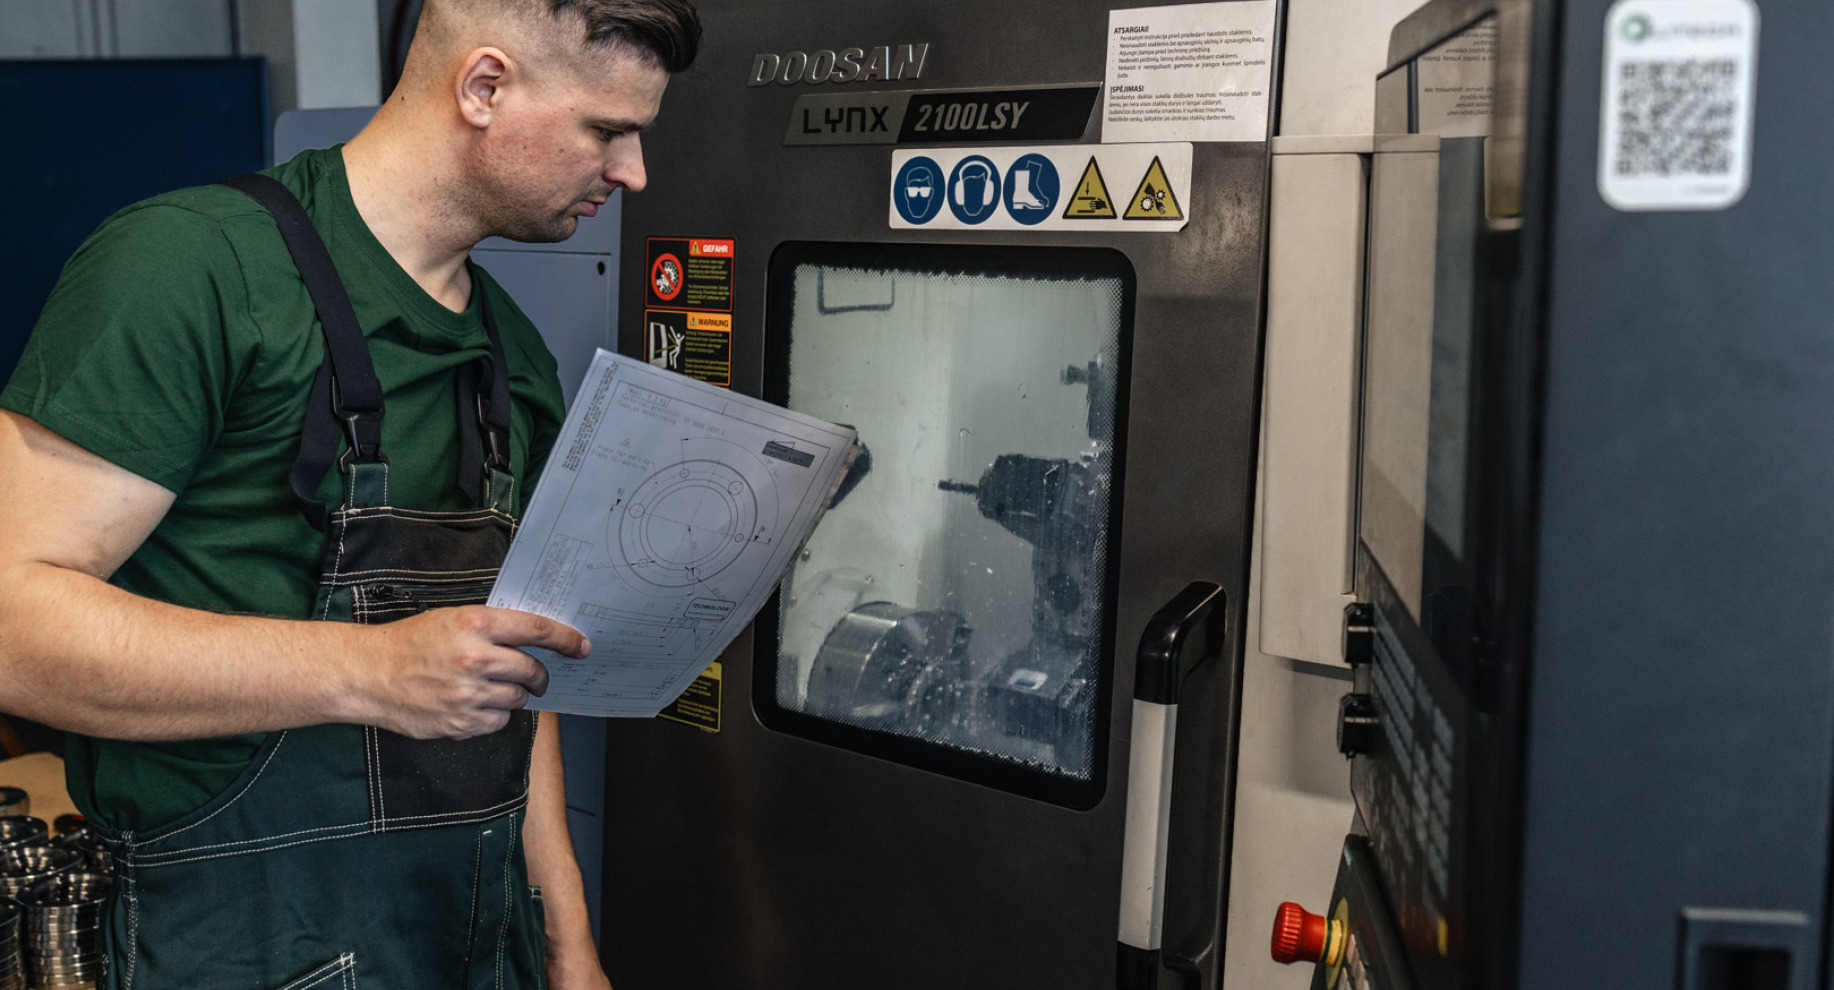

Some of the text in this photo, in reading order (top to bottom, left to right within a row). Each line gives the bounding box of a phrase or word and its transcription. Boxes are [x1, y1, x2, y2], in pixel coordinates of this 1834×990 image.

[747, 43, 929, 87] DOOSAN
[803, 101, 1030, 134] LYNX 2100LSY
[703, 244, 728, 253] GEFAHR
[698, 318, 729, 327] WARNUNG
